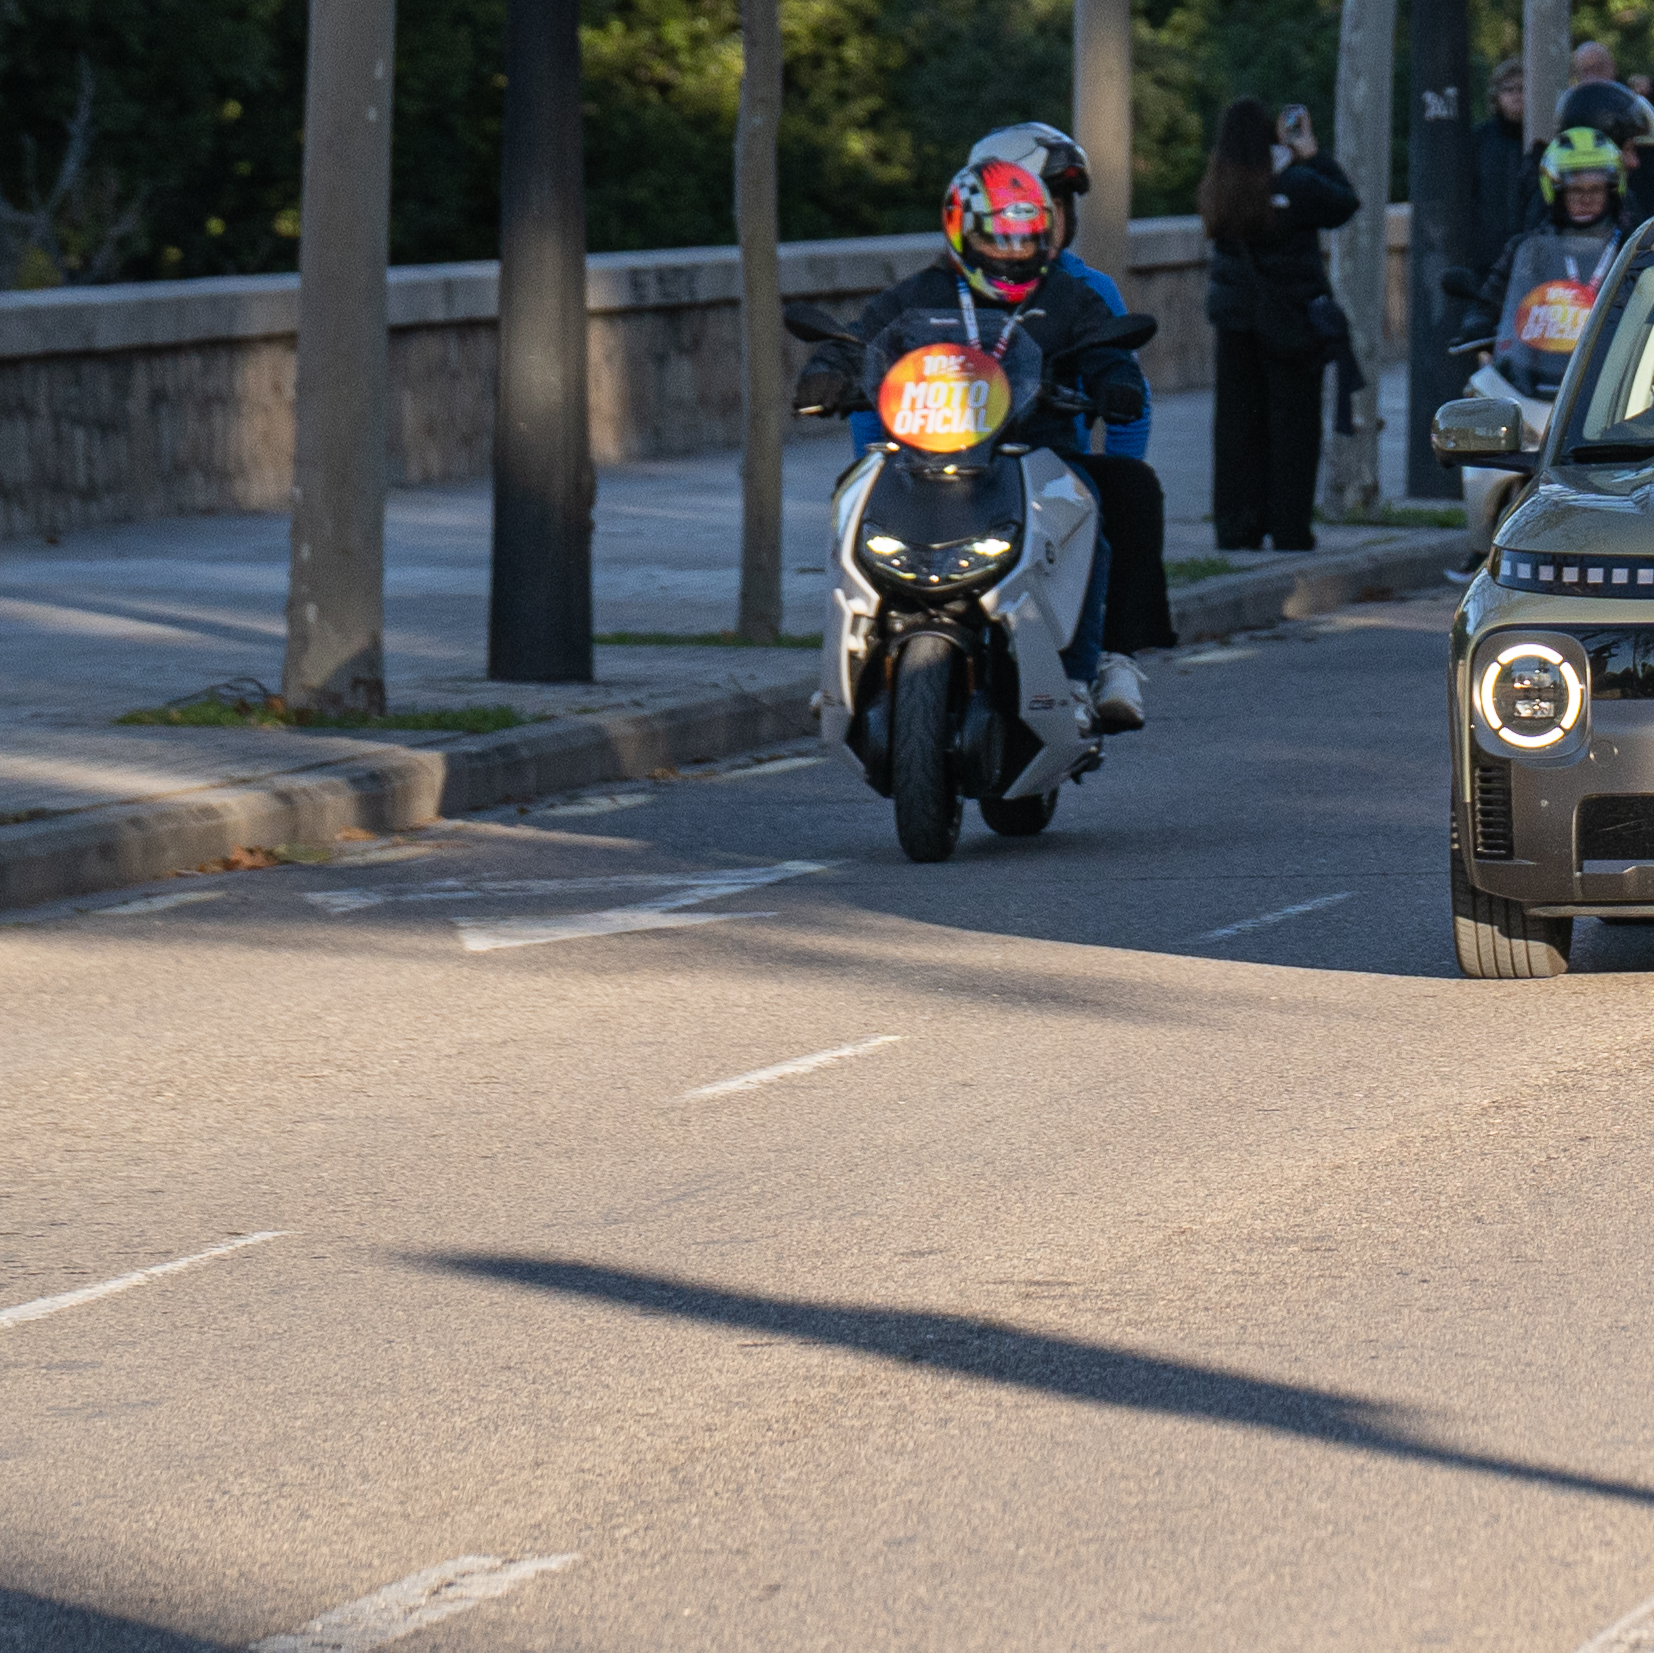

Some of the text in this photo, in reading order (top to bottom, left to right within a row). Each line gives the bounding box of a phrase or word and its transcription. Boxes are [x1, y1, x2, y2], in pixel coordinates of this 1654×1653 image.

[923, 355, 966, 377] 10K
[902, 380, 989, 409] MOTO
[894, 408, 991, 435] OFICIAL
